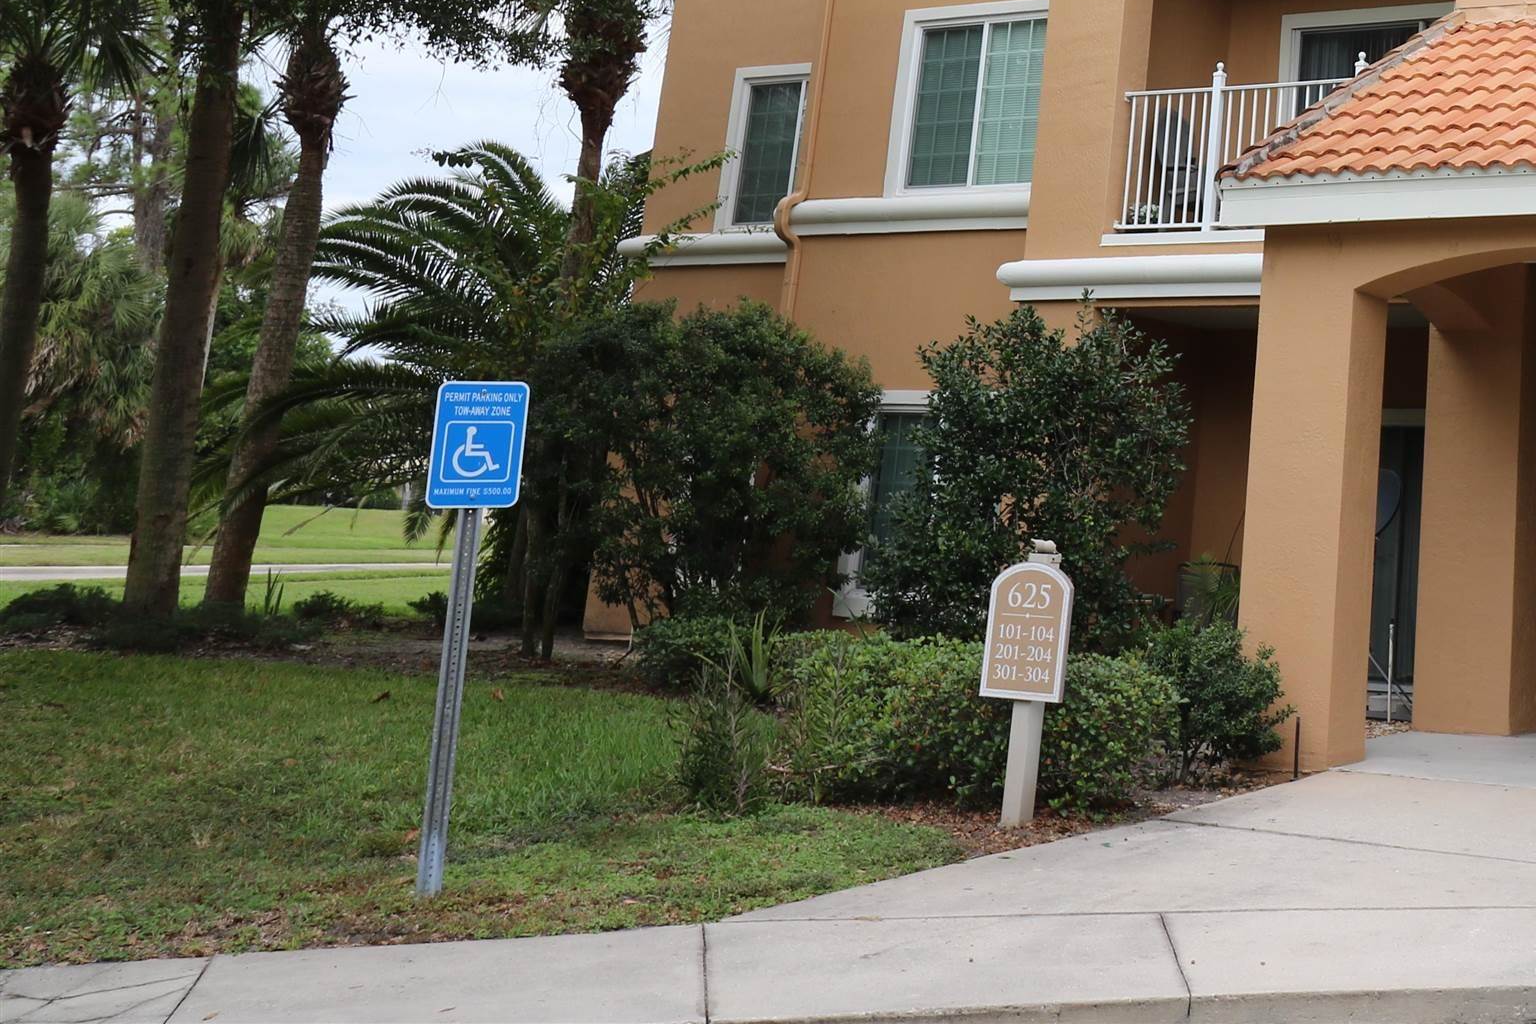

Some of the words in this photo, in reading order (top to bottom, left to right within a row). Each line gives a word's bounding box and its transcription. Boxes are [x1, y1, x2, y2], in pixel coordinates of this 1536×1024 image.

[445, 391, 471, 402] PERMIT
[471, 391, 503, 403] PARKING
[503, 392, 523, 403] ONLY
[454, 405, 490, 416] TOW-AWAY
[490, 406, 511, 417] ZONE
[433, 487, 464, 496] MAXIMUM
[465, 487, 481, 496] FINE
[1007, 582, 1052, 609] 625
[998, 623, 1055, 642] 101-104
[994, 643, 1053, 662] 201-204
[992, 663, 1050, 684] 301-304
